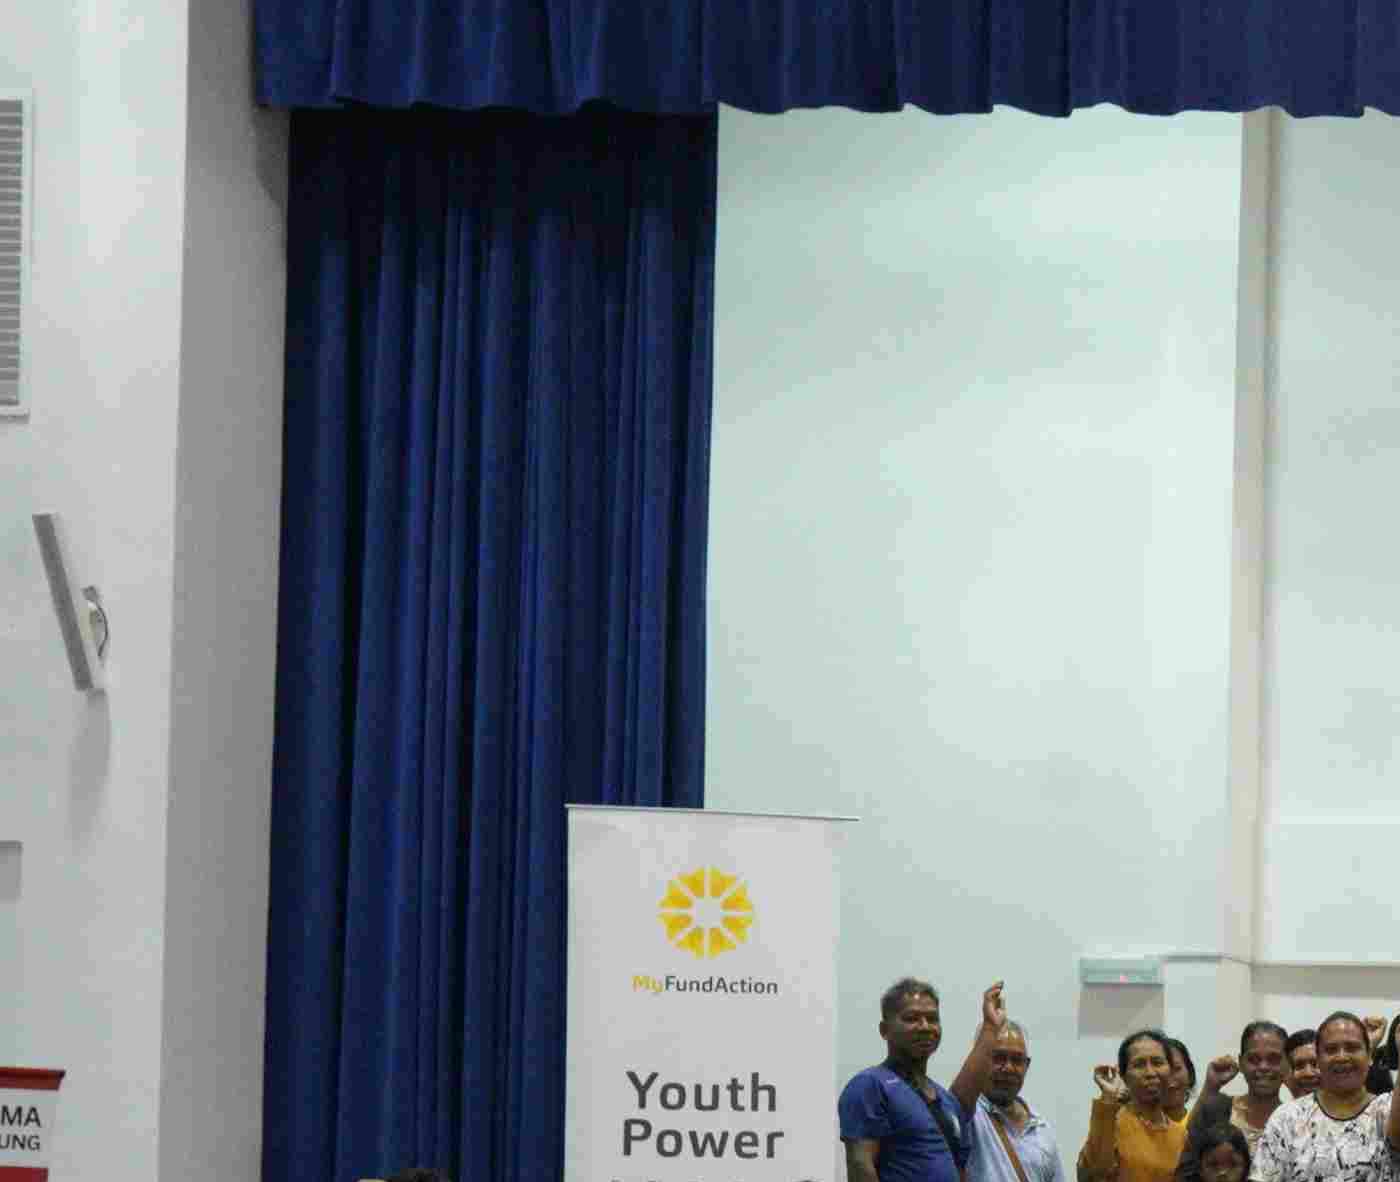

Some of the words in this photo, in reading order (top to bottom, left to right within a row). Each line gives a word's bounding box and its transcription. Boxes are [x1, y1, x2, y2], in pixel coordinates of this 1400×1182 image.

[631, 974, 778, 995] MyFundAction
[626, 1070, 777, 1112] Youth
[623, 1117, 784, 1159] Power
